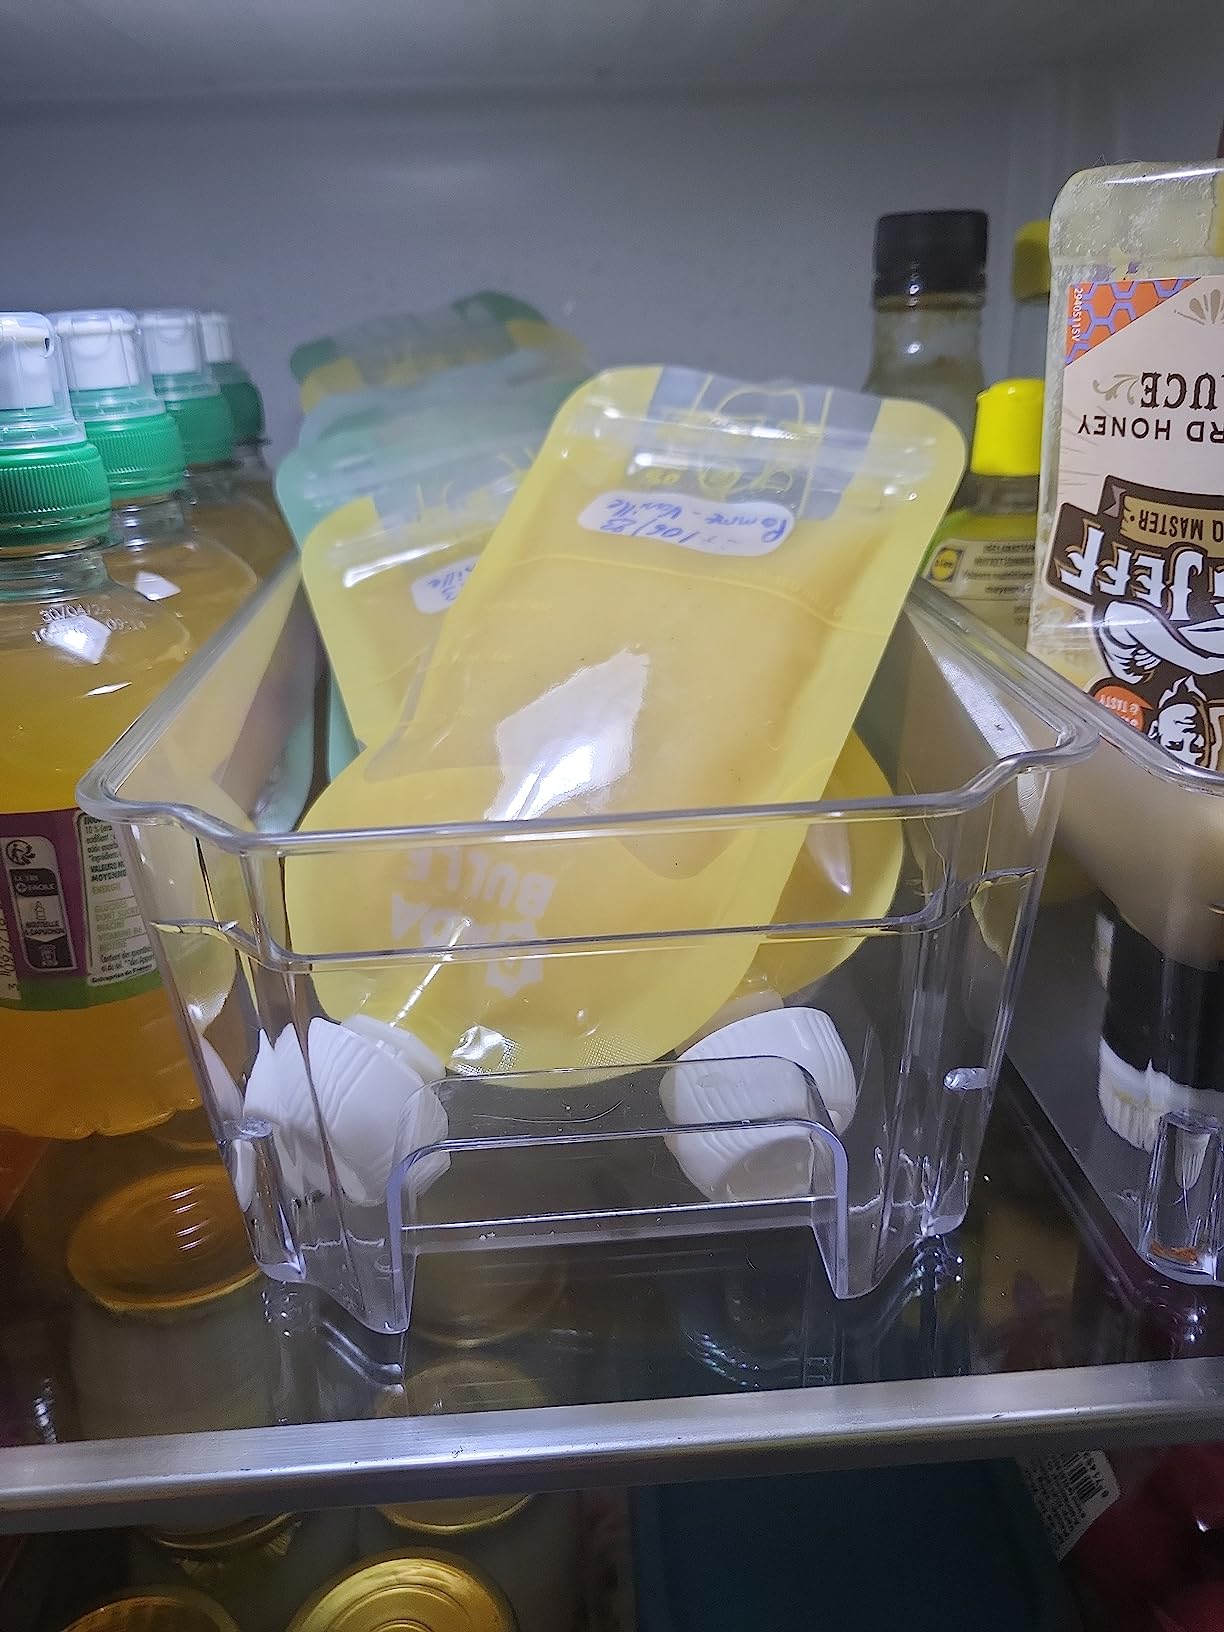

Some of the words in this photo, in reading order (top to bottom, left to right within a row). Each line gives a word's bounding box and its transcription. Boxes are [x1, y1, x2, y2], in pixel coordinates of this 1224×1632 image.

[1140, 371, 1224, 411] UCE
[1077, 414, 1171, 441] HONEY
[1137, 509, 1204, 540] MASTER
[1056, 521, 1205, 621] JEFF
